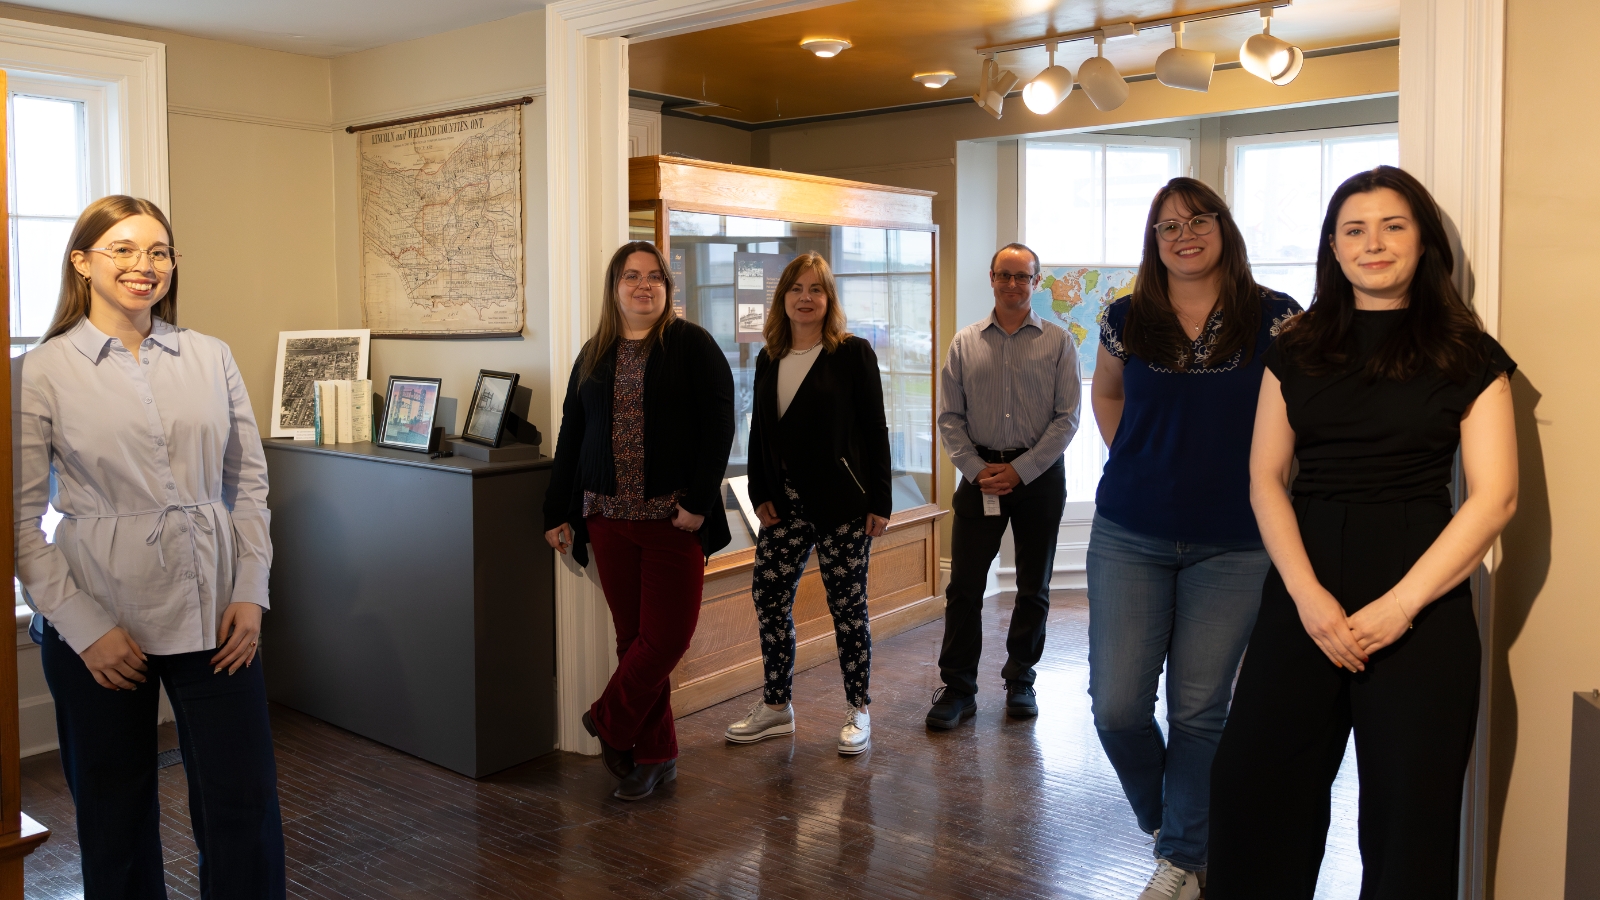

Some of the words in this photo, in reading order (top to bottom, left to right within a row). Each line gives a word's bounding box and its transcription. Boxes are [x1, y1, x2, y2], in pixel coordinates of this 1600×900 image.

[372, 132, 394, 145] LINCOLN
[396, 131, 407, 141] and
[408, 126, 436, 138] WELLAND
